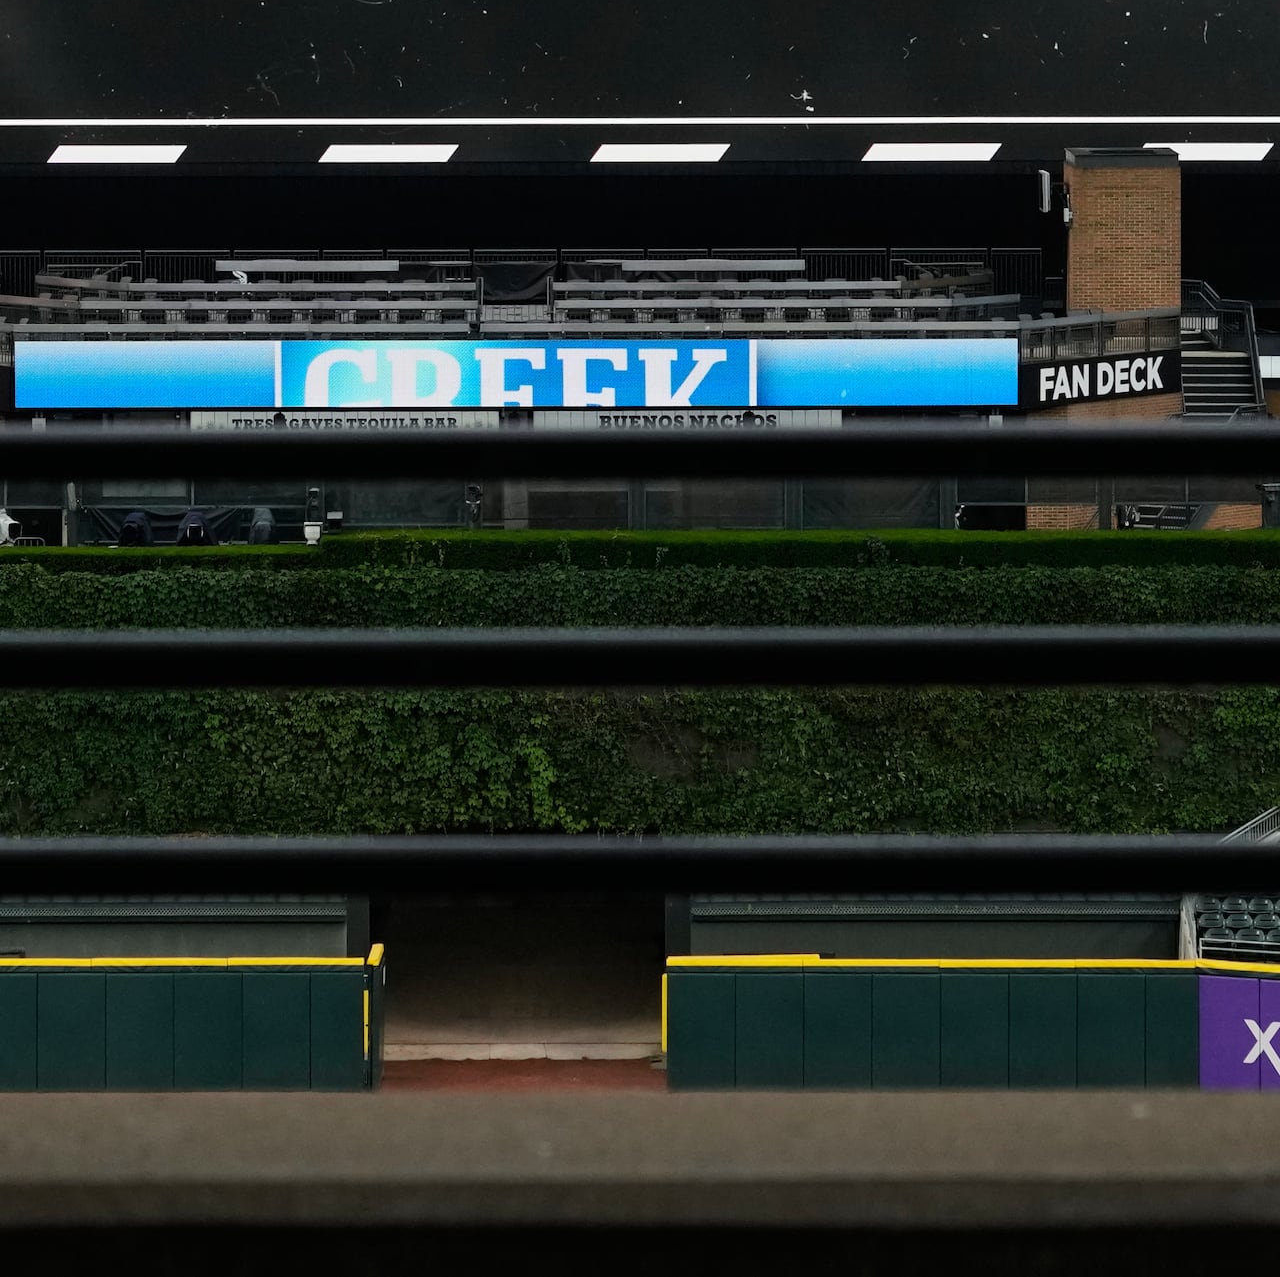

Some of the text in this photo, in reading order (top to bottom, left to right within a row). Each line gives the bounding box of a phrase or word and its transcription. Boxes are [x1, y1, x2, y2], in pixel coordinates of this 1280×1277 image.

[1038, 356, 1164, 402] FAN DECK
[232, 418, 274, 429] TRES
[346, 417, 419, 429] TEQUILA
[423, 417, 458, 429] BAR
[600, 415, 685, 429] BUENOS
